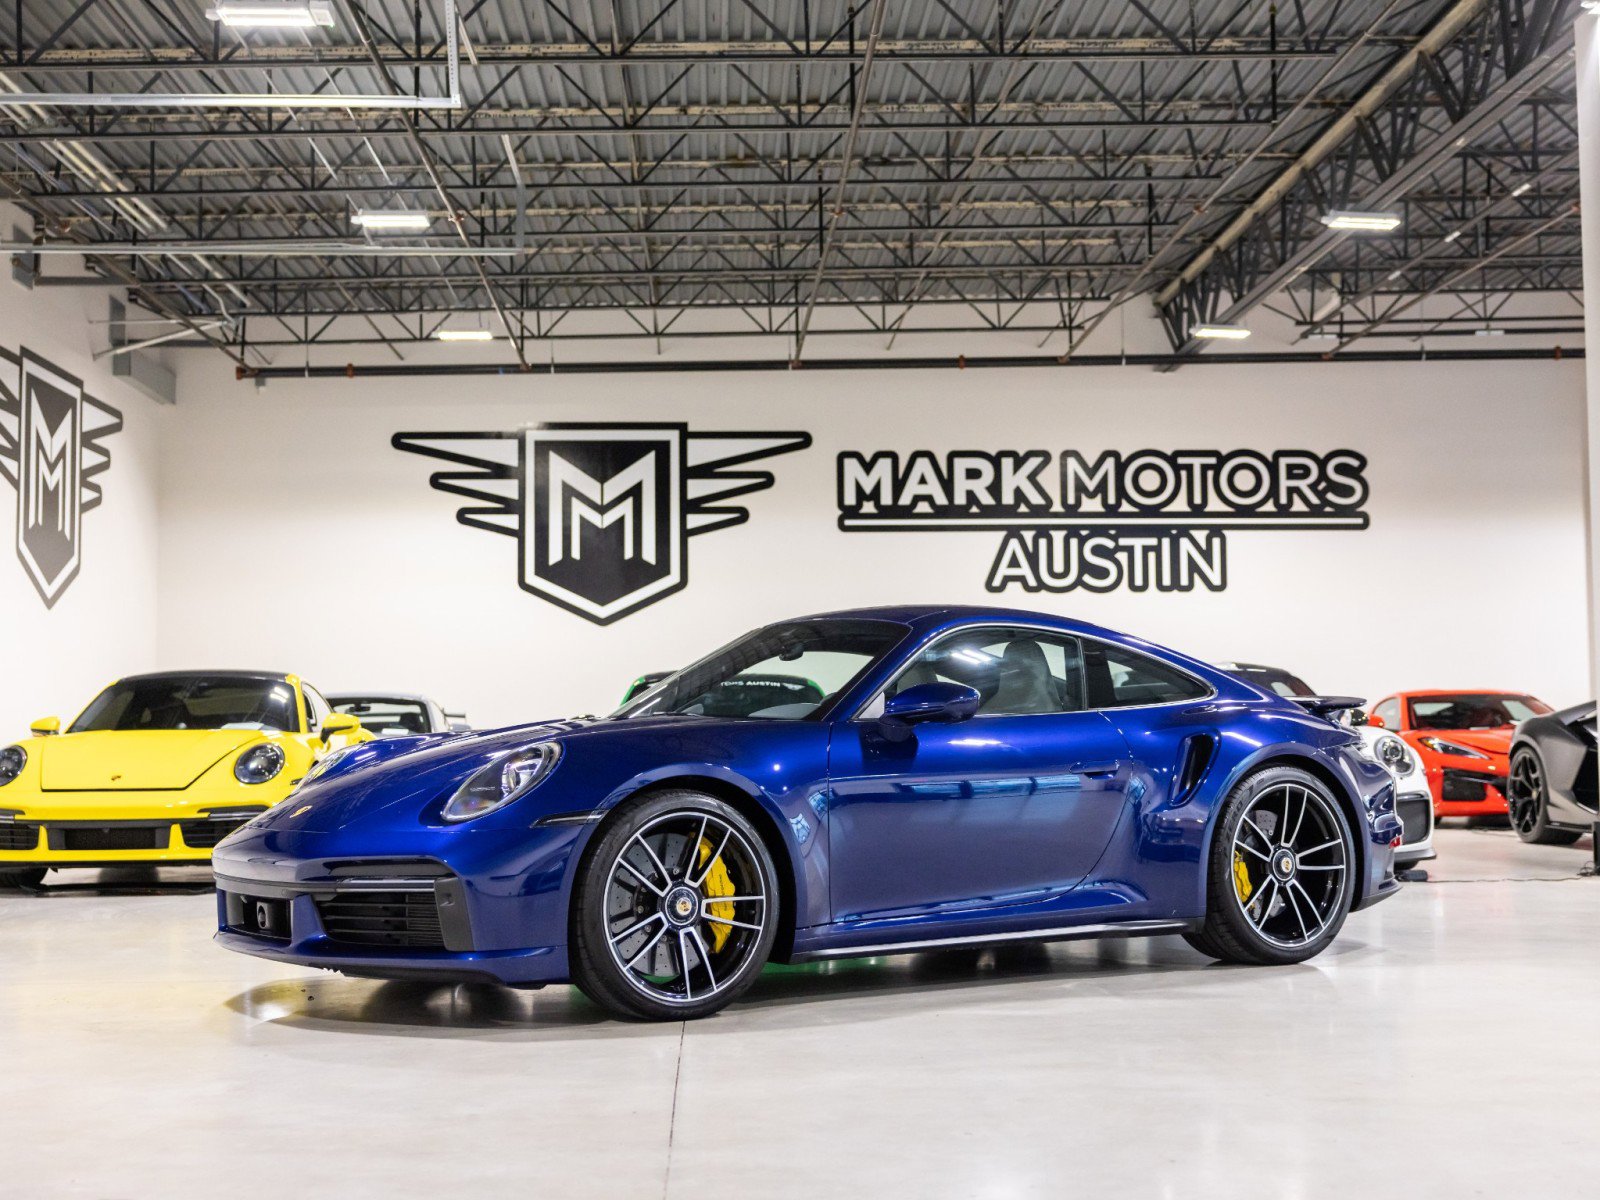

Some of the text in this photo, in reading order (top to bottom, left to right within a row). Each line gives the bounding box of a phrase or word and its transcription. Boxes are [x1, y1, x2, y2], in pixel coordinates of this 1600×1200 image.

[841, 454, 1366, 508] MARK MOTORS
[989, 535, 1224, 589] AUSTIN
[745, 680, 781, 688] AUSTIN
